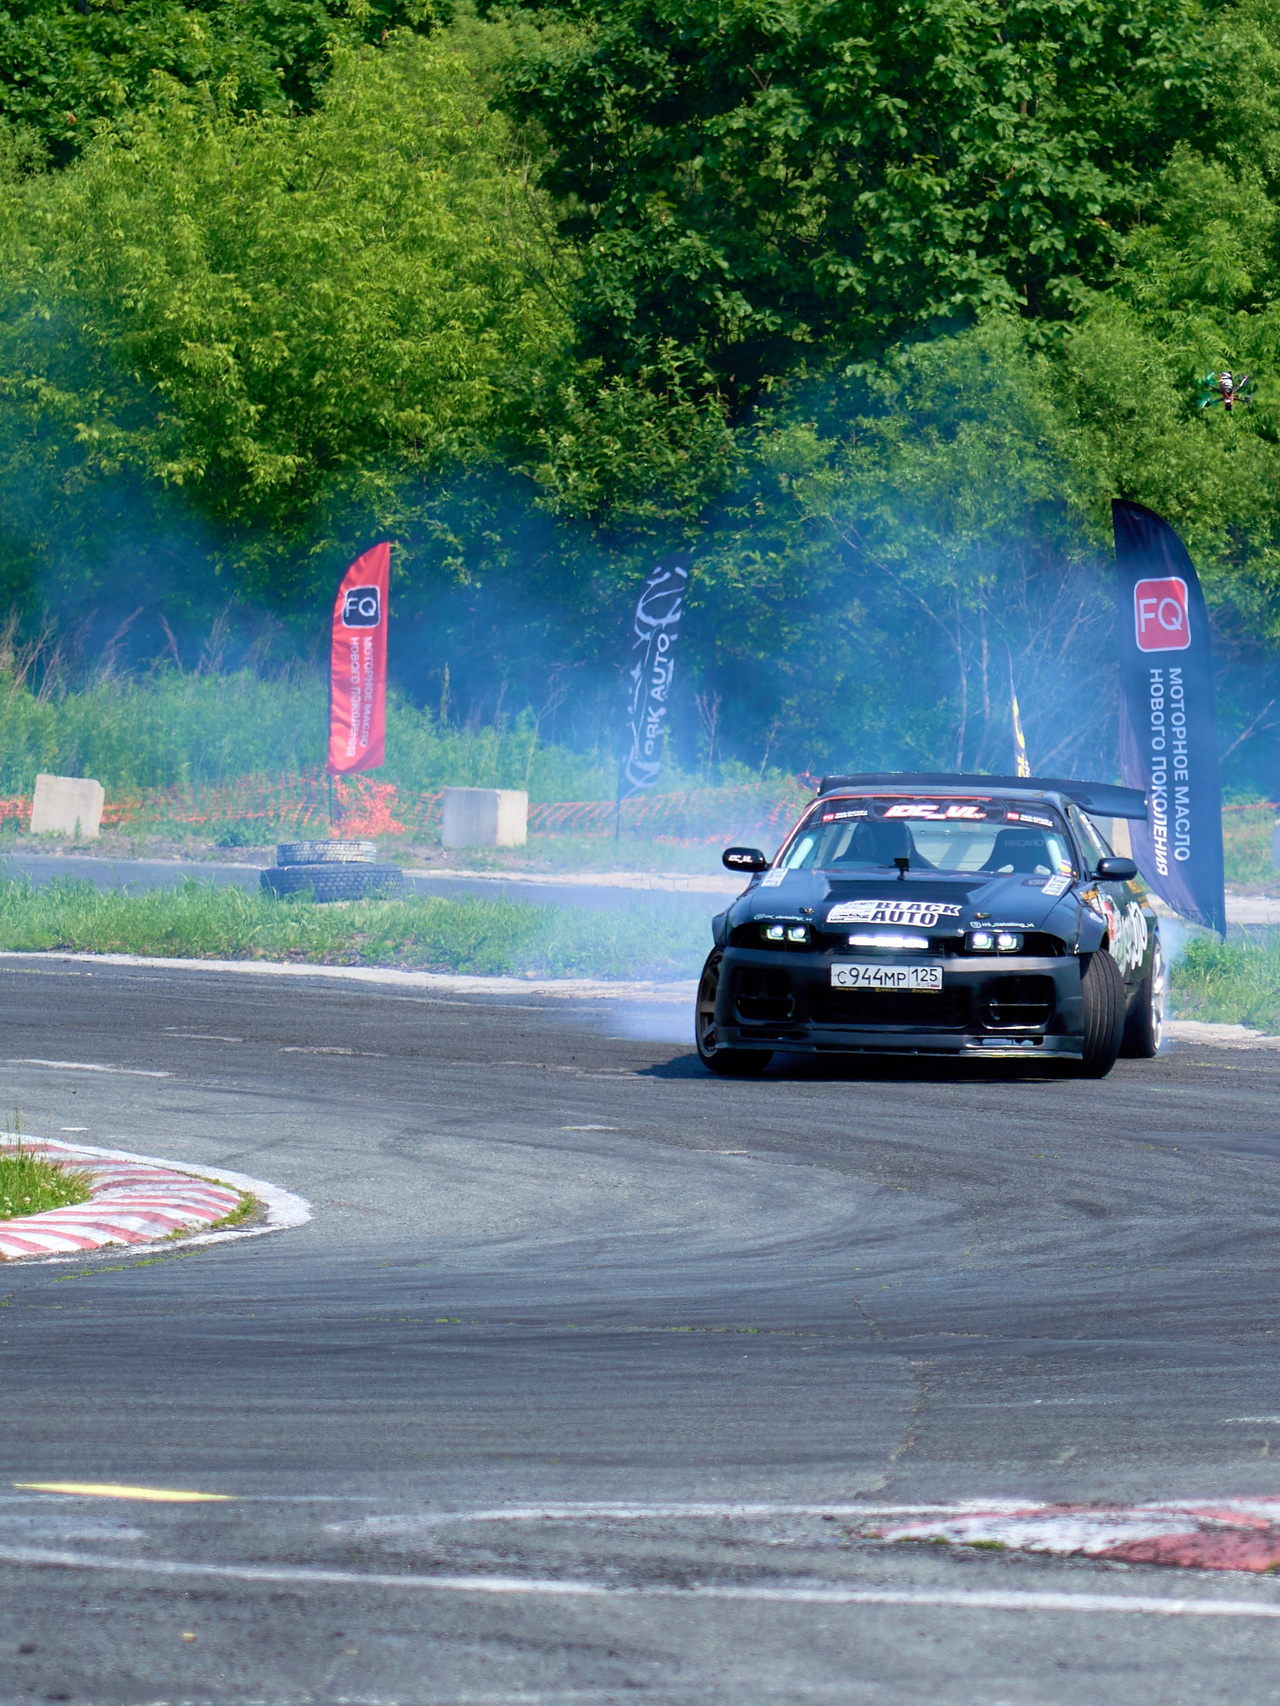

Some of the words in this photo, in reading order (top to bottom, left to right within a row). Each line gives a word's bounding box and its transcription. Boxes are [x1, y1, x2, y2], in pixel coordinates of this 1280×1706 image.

[345, 597, 377, 618] FQ
[1139, 596, 1183, 633] FQ
[350, 636, 361, 684] НОВОГО
[363, 636, 373, 701] МОТОРНОЕ
[650, 633, 670, 701] AUTO
[360, 703, 371, 747] МАСЛО
[1150, 669, 1166, 751] НОВОГО
[1169, 667, 1188, 781] МОТОРНОЕ
[1152, 757, 1169, 876] ПОКОЛЕНИЯ
[1174, 786, 1190, 861] МАСЛО
[1004, 839, 1044, 848] RECARO
[870, 910, 937, 925] AUTO
[874, 902, 959, 914] BLACK
[911, 968, 938, 982] 125
